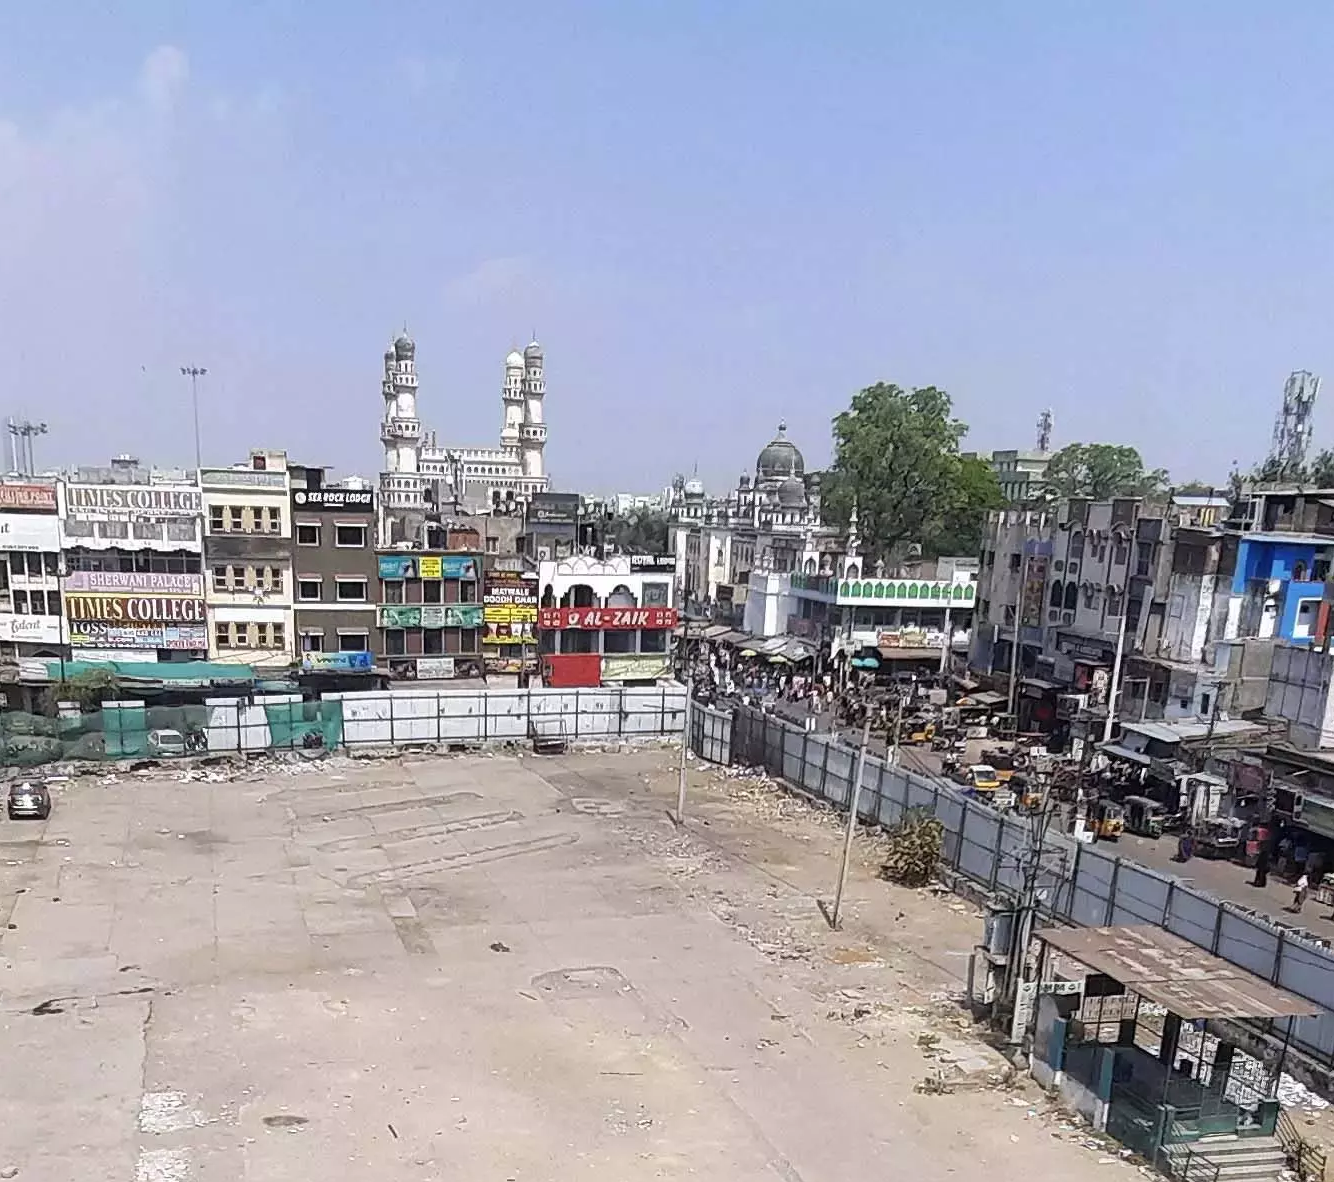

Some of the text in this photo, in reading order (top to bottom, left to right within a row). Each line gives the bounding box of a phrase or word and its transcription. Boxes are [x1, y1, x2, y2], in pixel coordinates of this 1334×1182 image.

[69, 488, 201, 510] TIMES COLLEGE
[90, 573, 191, 588] SHERWANI PALACE
[69, 597, 205, 620] TIMES COLLEGE
[584, 611, 649, 626] AL-ZAIK
[71, 622, 107, 635] TOSS
